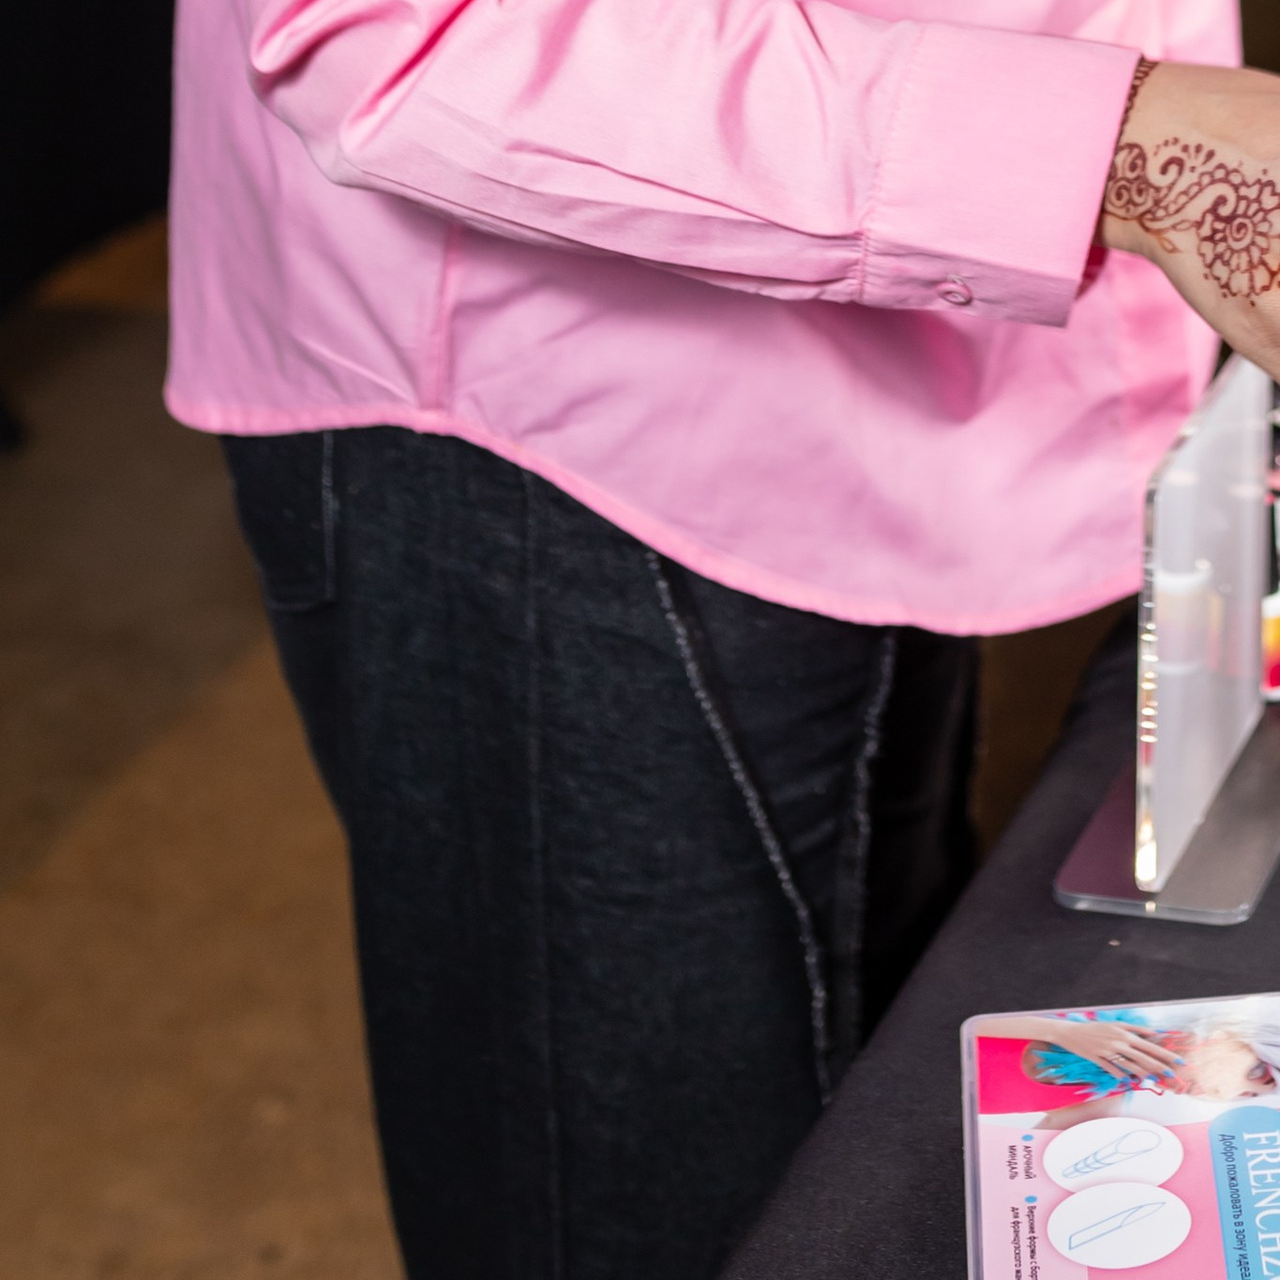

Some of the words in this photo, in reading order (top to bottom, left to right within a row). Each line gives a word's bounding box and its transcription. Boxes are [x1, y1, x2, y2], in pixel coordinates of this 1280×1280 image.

[1007, 1145, 1018, 1180] МИНДАЛЬ
[1023, 1145, 1037, 1180] АРОЧНЫЙ
[1219, 1134, 1237, 1162] Добро
[1227, 1165, 1242, 1219] пожаловать
[1233, 1228, 1247, 1251] зону
